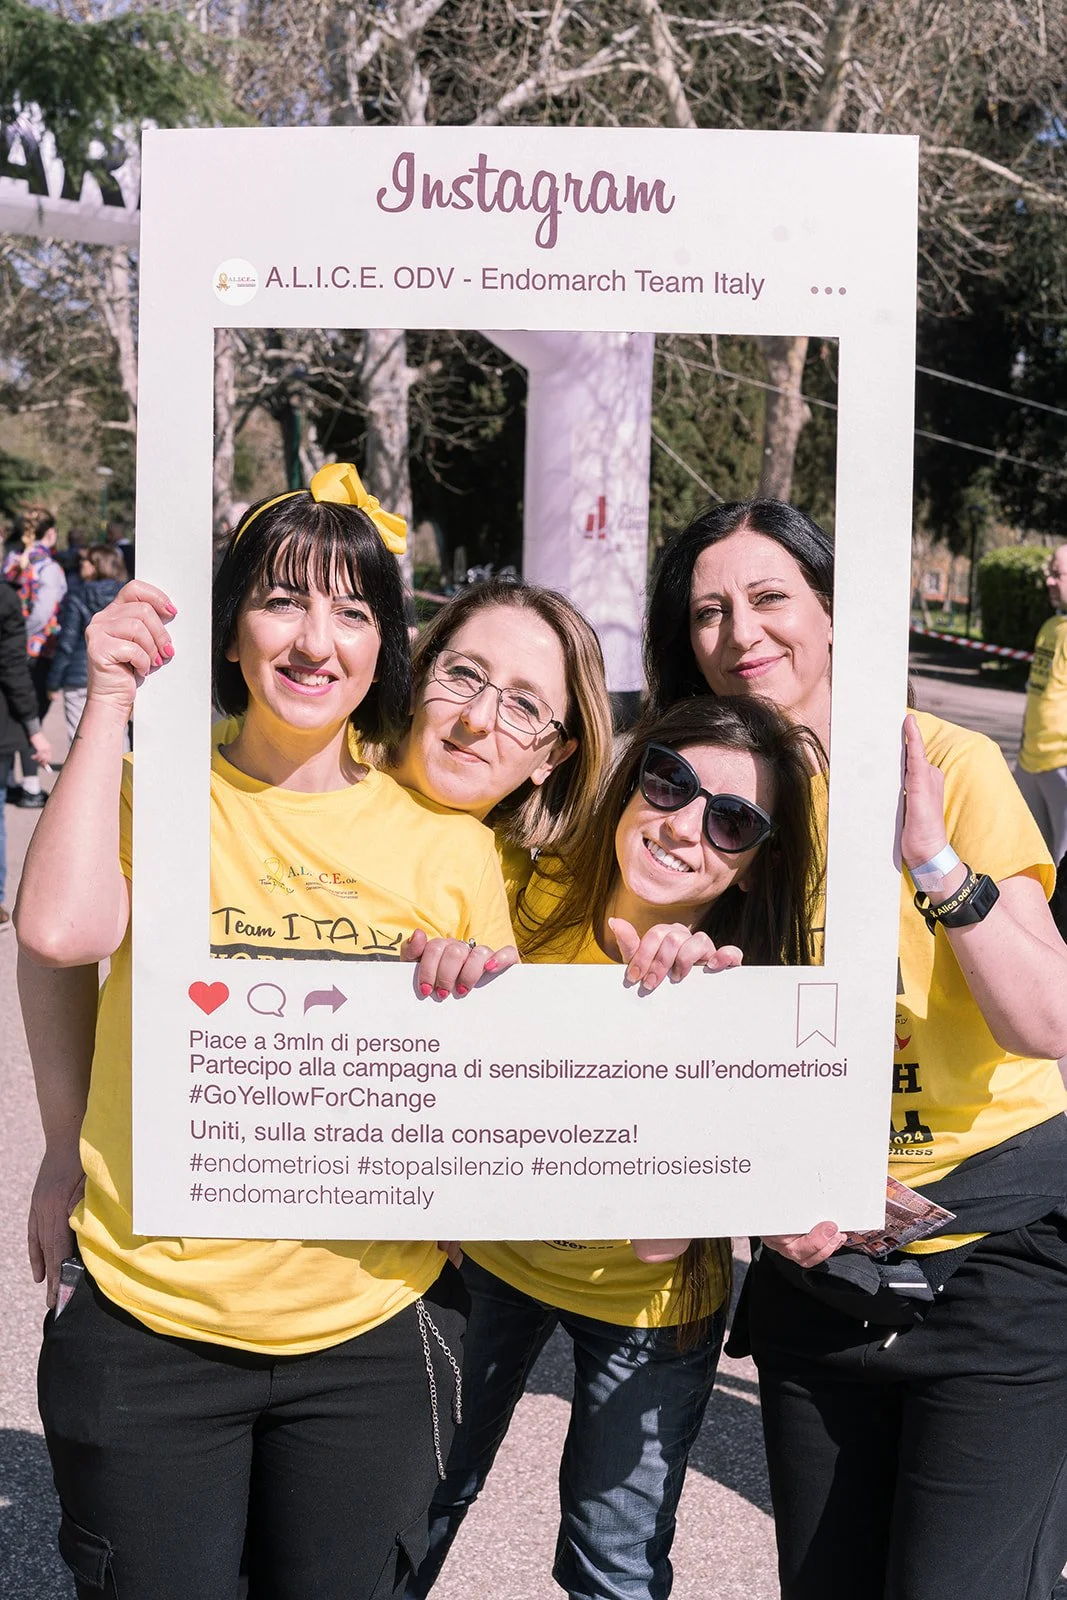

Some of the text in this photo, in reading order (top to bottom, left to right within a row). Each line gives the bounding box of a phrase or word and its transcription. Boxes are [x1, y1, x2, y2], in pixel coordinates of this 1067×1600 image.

[376, 151, 676, 250] Instagram
[264, 265, 384, 289] A.L.I.C.E.
[393, 266, 455, 290] ODV
[481, 267, 626, 292] Endomarch
[633, 269, 704, 294] Team
[714, 271, 766, 301] Italy
[937, 886, 971, 915] Alice odv
[212, 906, 276, 938] Team
[189, 1030, 441, 1056] Piace a 3mln di persone
[190, 1054, 848, 1083] Partecipo alla campagna di sensibilizzazione sull’endometriosi
[189, 1083, 437, 1114] #GoYellowForChange
[190, 1119, 638, 1149] Uniti, sulla strada della consapevolezza!
[890, 1130, 925, 1145] 024
[189, 1152, 752, 1181] #endometriosi #stopalsilenzio #endometriosiesiste
[189, 1182, 435, 1210] #endomarchteamitaly
